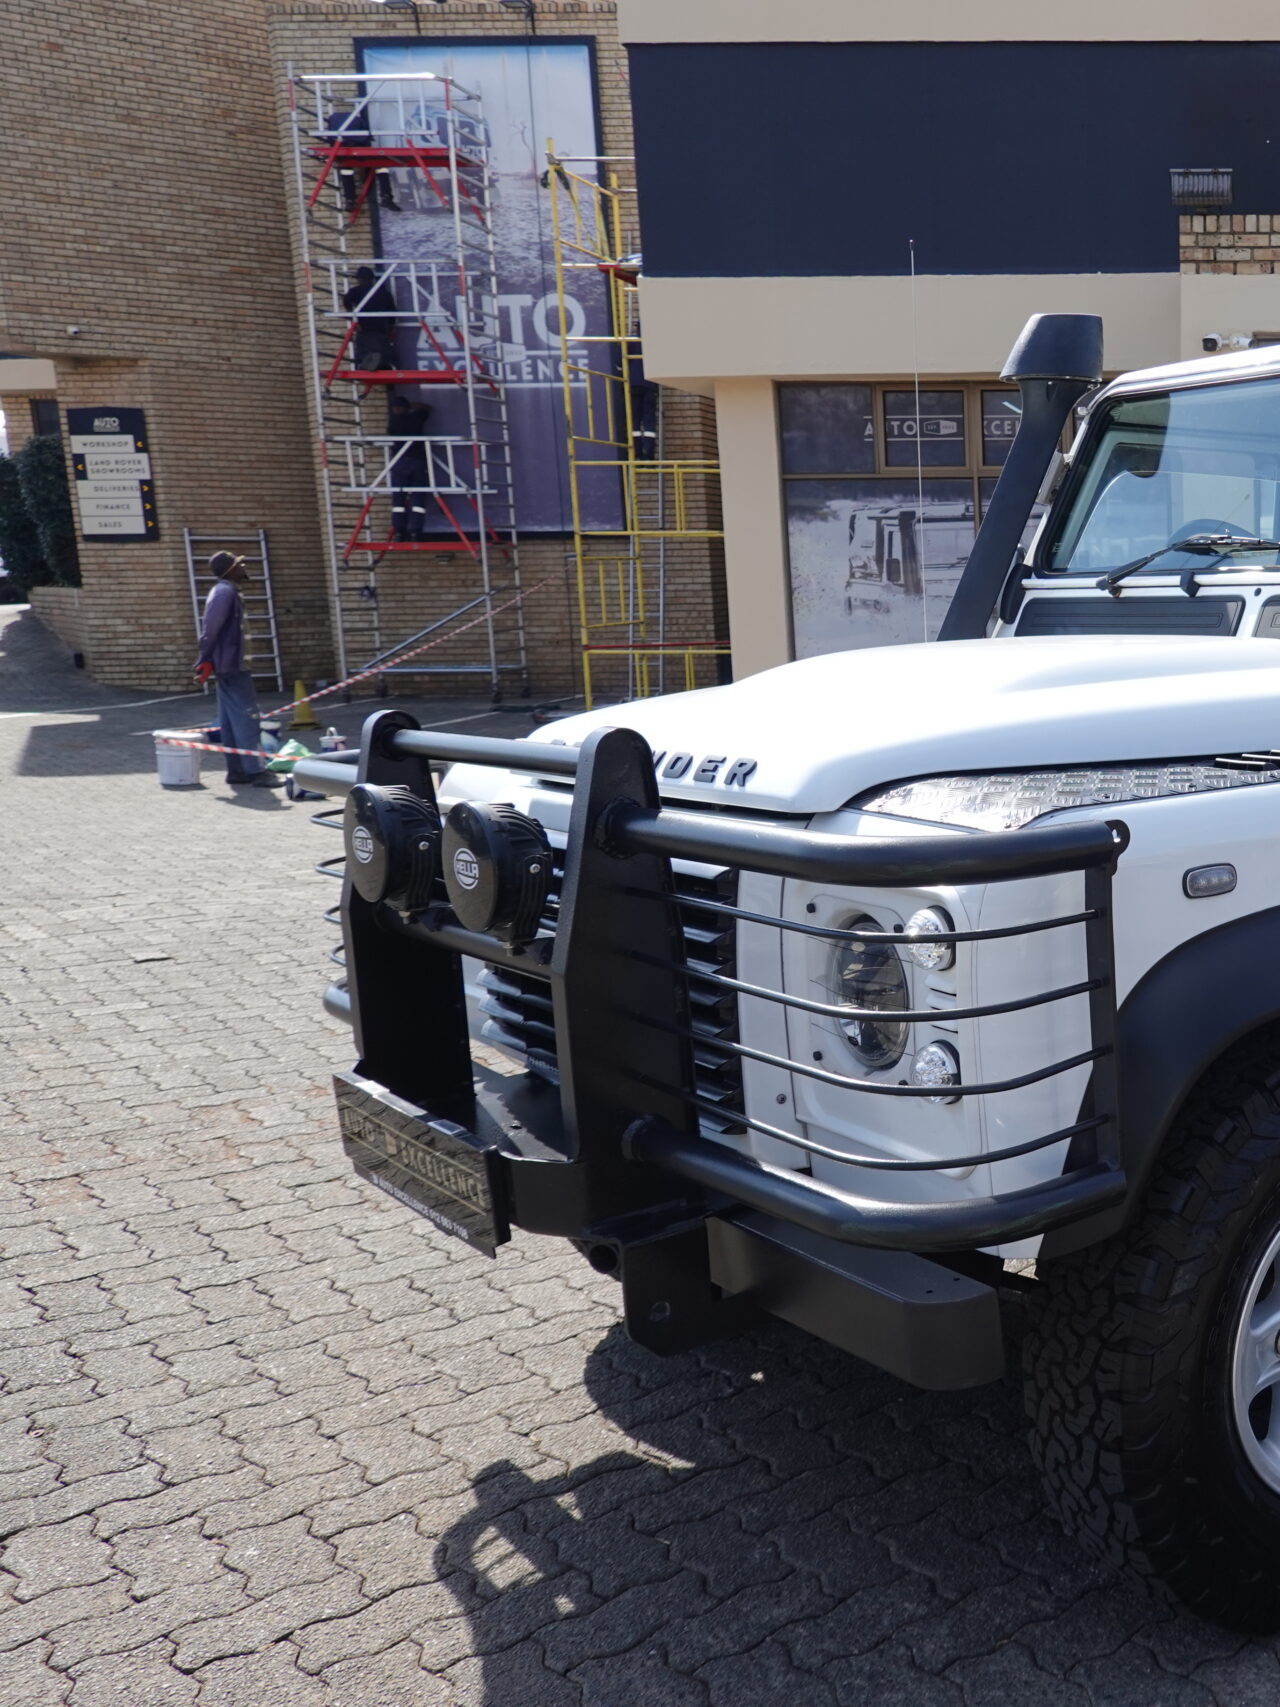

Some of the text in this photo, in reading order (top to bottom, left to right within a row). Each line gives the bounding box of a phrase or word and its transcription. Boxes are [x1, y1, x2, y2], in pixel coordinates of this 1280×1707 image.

[863, 420, 917, 436] ATO
[353, 838, 373, 854] HELLA
[455, 861, 479, 880] HELLA
[400, 1141, 485, 1208] EXCELLENCE
